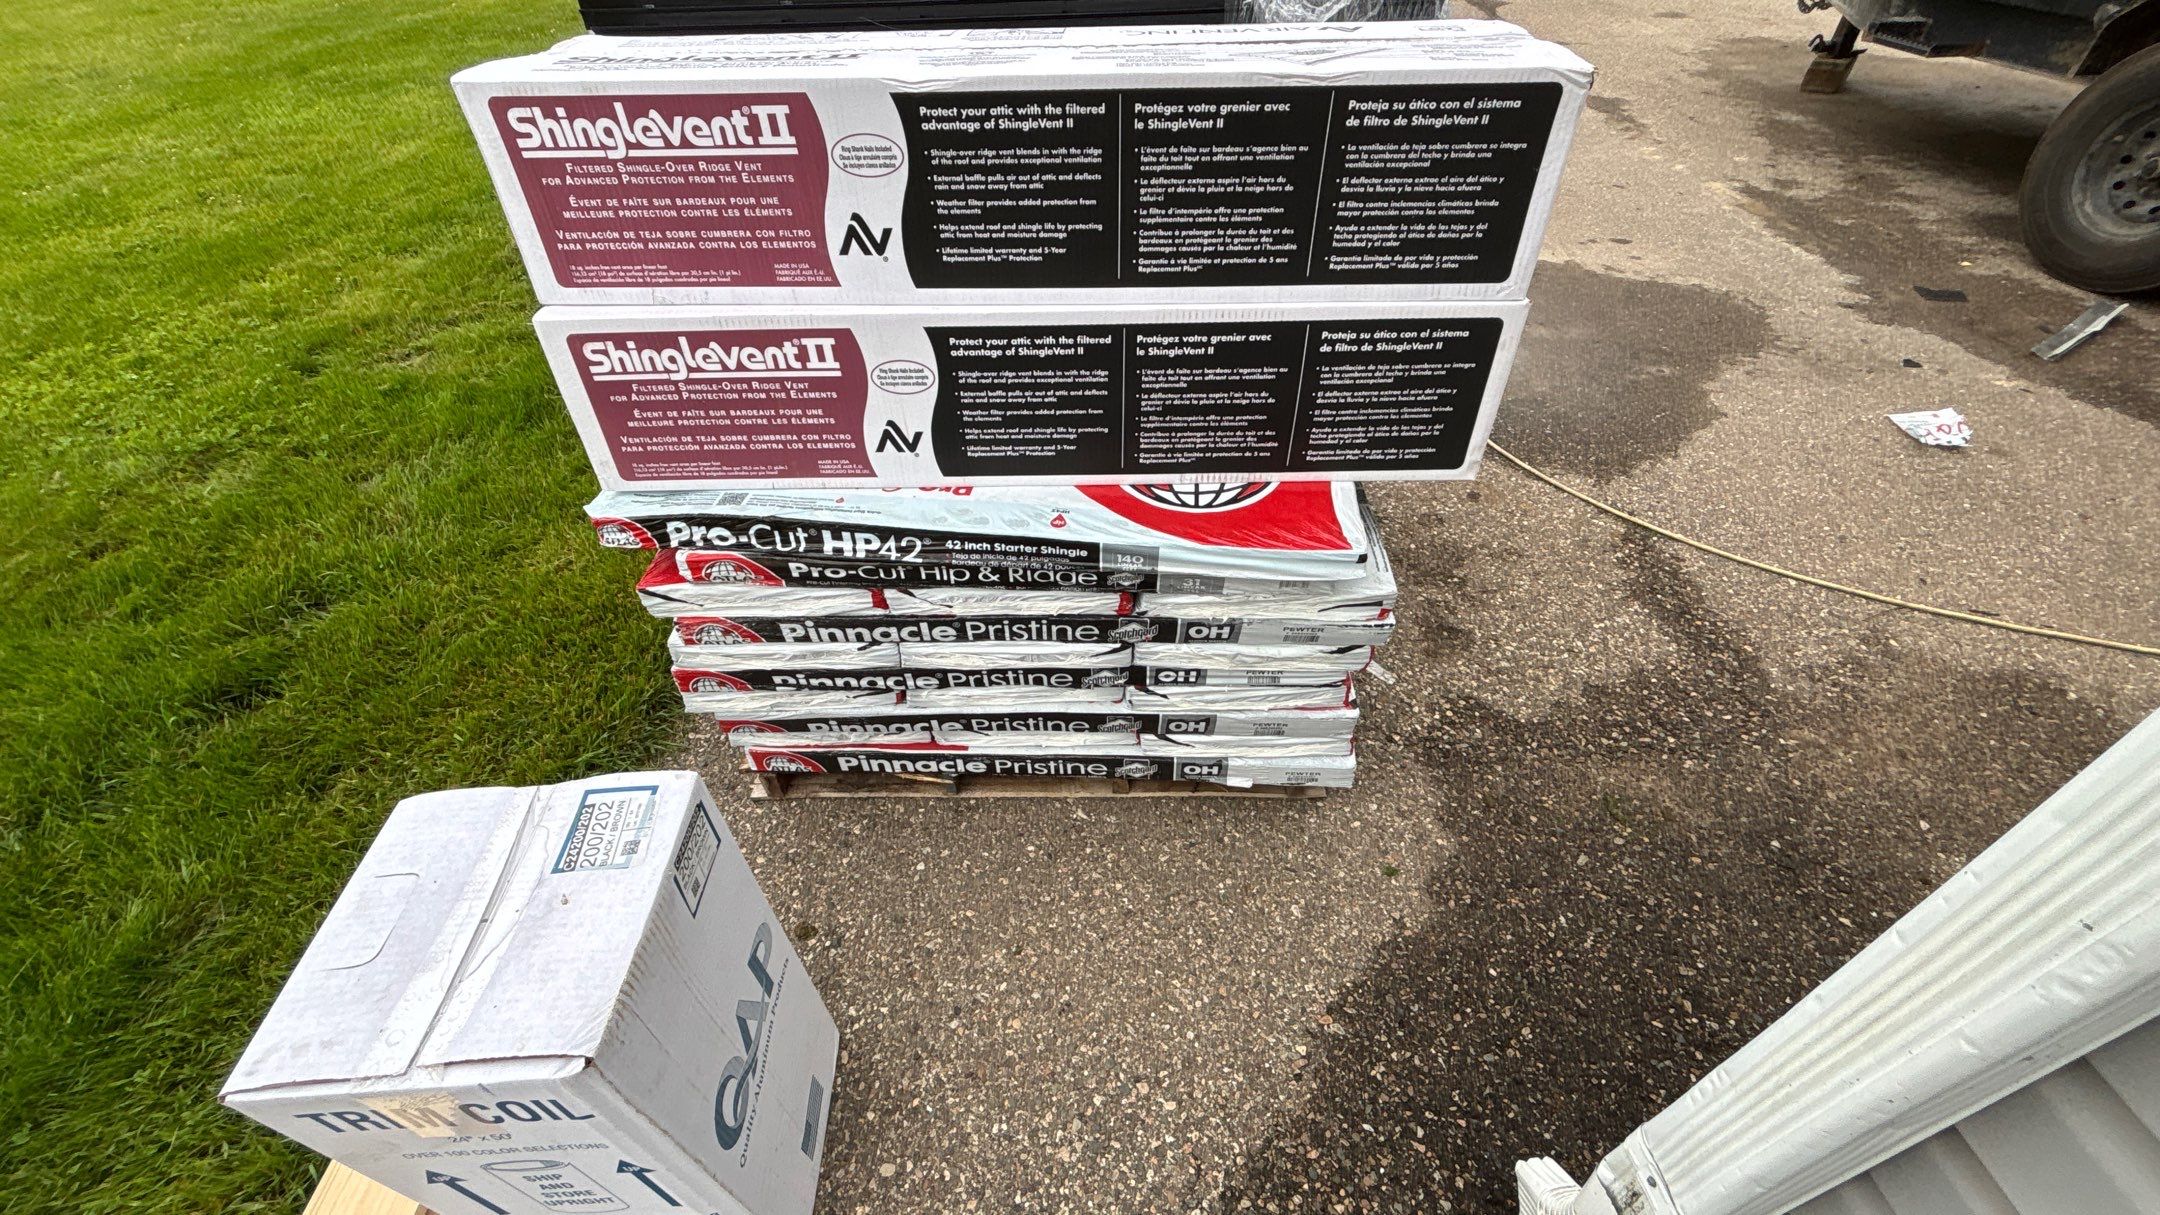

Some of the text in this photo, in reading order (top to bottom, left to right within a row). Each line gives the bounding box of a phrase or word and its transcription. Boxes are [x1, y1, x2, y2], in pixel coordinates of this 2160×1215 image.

[919, 102, 1105, 119] Protect your attic with the filtered
[1134, 102, 1290, 116] Protégez votre grenier avec
[1348, 97, 1522, 113] Proteja su ático con el sistema
[750, 105, 797, 145] II
[921, 117, 1073, 132] advantage of ShingleVent II
[1134, 117, 1224, 132] le ShingleVent II
[1345, 114, 1490, 128] de filtro de ShingleVent II
[734, 160, 762, 171] VENT
[541, 172, 794, 186] FOR ADVANCED PROTECTION FROM THE ELEMENTS
[606, 198, 619, 207] DE
[652, 198, 672, 206] SUR
[675, 197, 726, 206] BARDEAUX
[730, 197, 756, 205] POUR
[760, 196, 779, 205] UNE
[562, 210, 615, 218] MEILLEURE
[618, 209, 677, 218] PROTECTION
[680, 209, 718, 217] CONTRE
[722, 208, 740, 217] LES
[949, 334, 1111, 347] Protect your attic with the filtered
[800, 337, 840, 370] II
[950, 346, 1084, 358] advantage of ShingleVent II
[945, 540, 1088, 557] 42 Inch Starter Shingle
[1117, 554, 1144, 564] 140
[919, 565, 970, 584] Hip
[977, 567, 1000, 582] &
[966, 620, 1099, 641] Pristine
[1108, 626, 1159, 643] Scotchgard
[1188, 626, 1230, 639] OH
[948, 670, 1073, 688] Pristine
[1081, 671, 1129, 686] Scotchgard
[1157, 671, 1198, 682] OH
[972, 717, 1090, 732] Pristine
[1168, 721, 1206, 733] OH
[995, 757, 1108, 775] Pristine
[1183, 765, 1220, 775] OH
[563, 806, 594, 871] C24200/202
[580, 800, 615, 869] 200/202
[600, 839, 615, 867] BLACK
[610, 801, 626, 832] BROWN
[740, 957, 789, 1168] Quality Aluminum Products
[294, 1099, 595, 1133] TRIM COIL
[402, 1150, 444, 1160] OVER
[472, 1147, 523, 1156] COLOR
[523, 1142, 610, 1153] SELECTIONS
[521, 1173, 563, 1183] SHIP
[538, 1182, 573, 1190] AND
[541, 1189, 598, 1198] STORE
[544, 1197, 614, 1207] UPRIGHT
